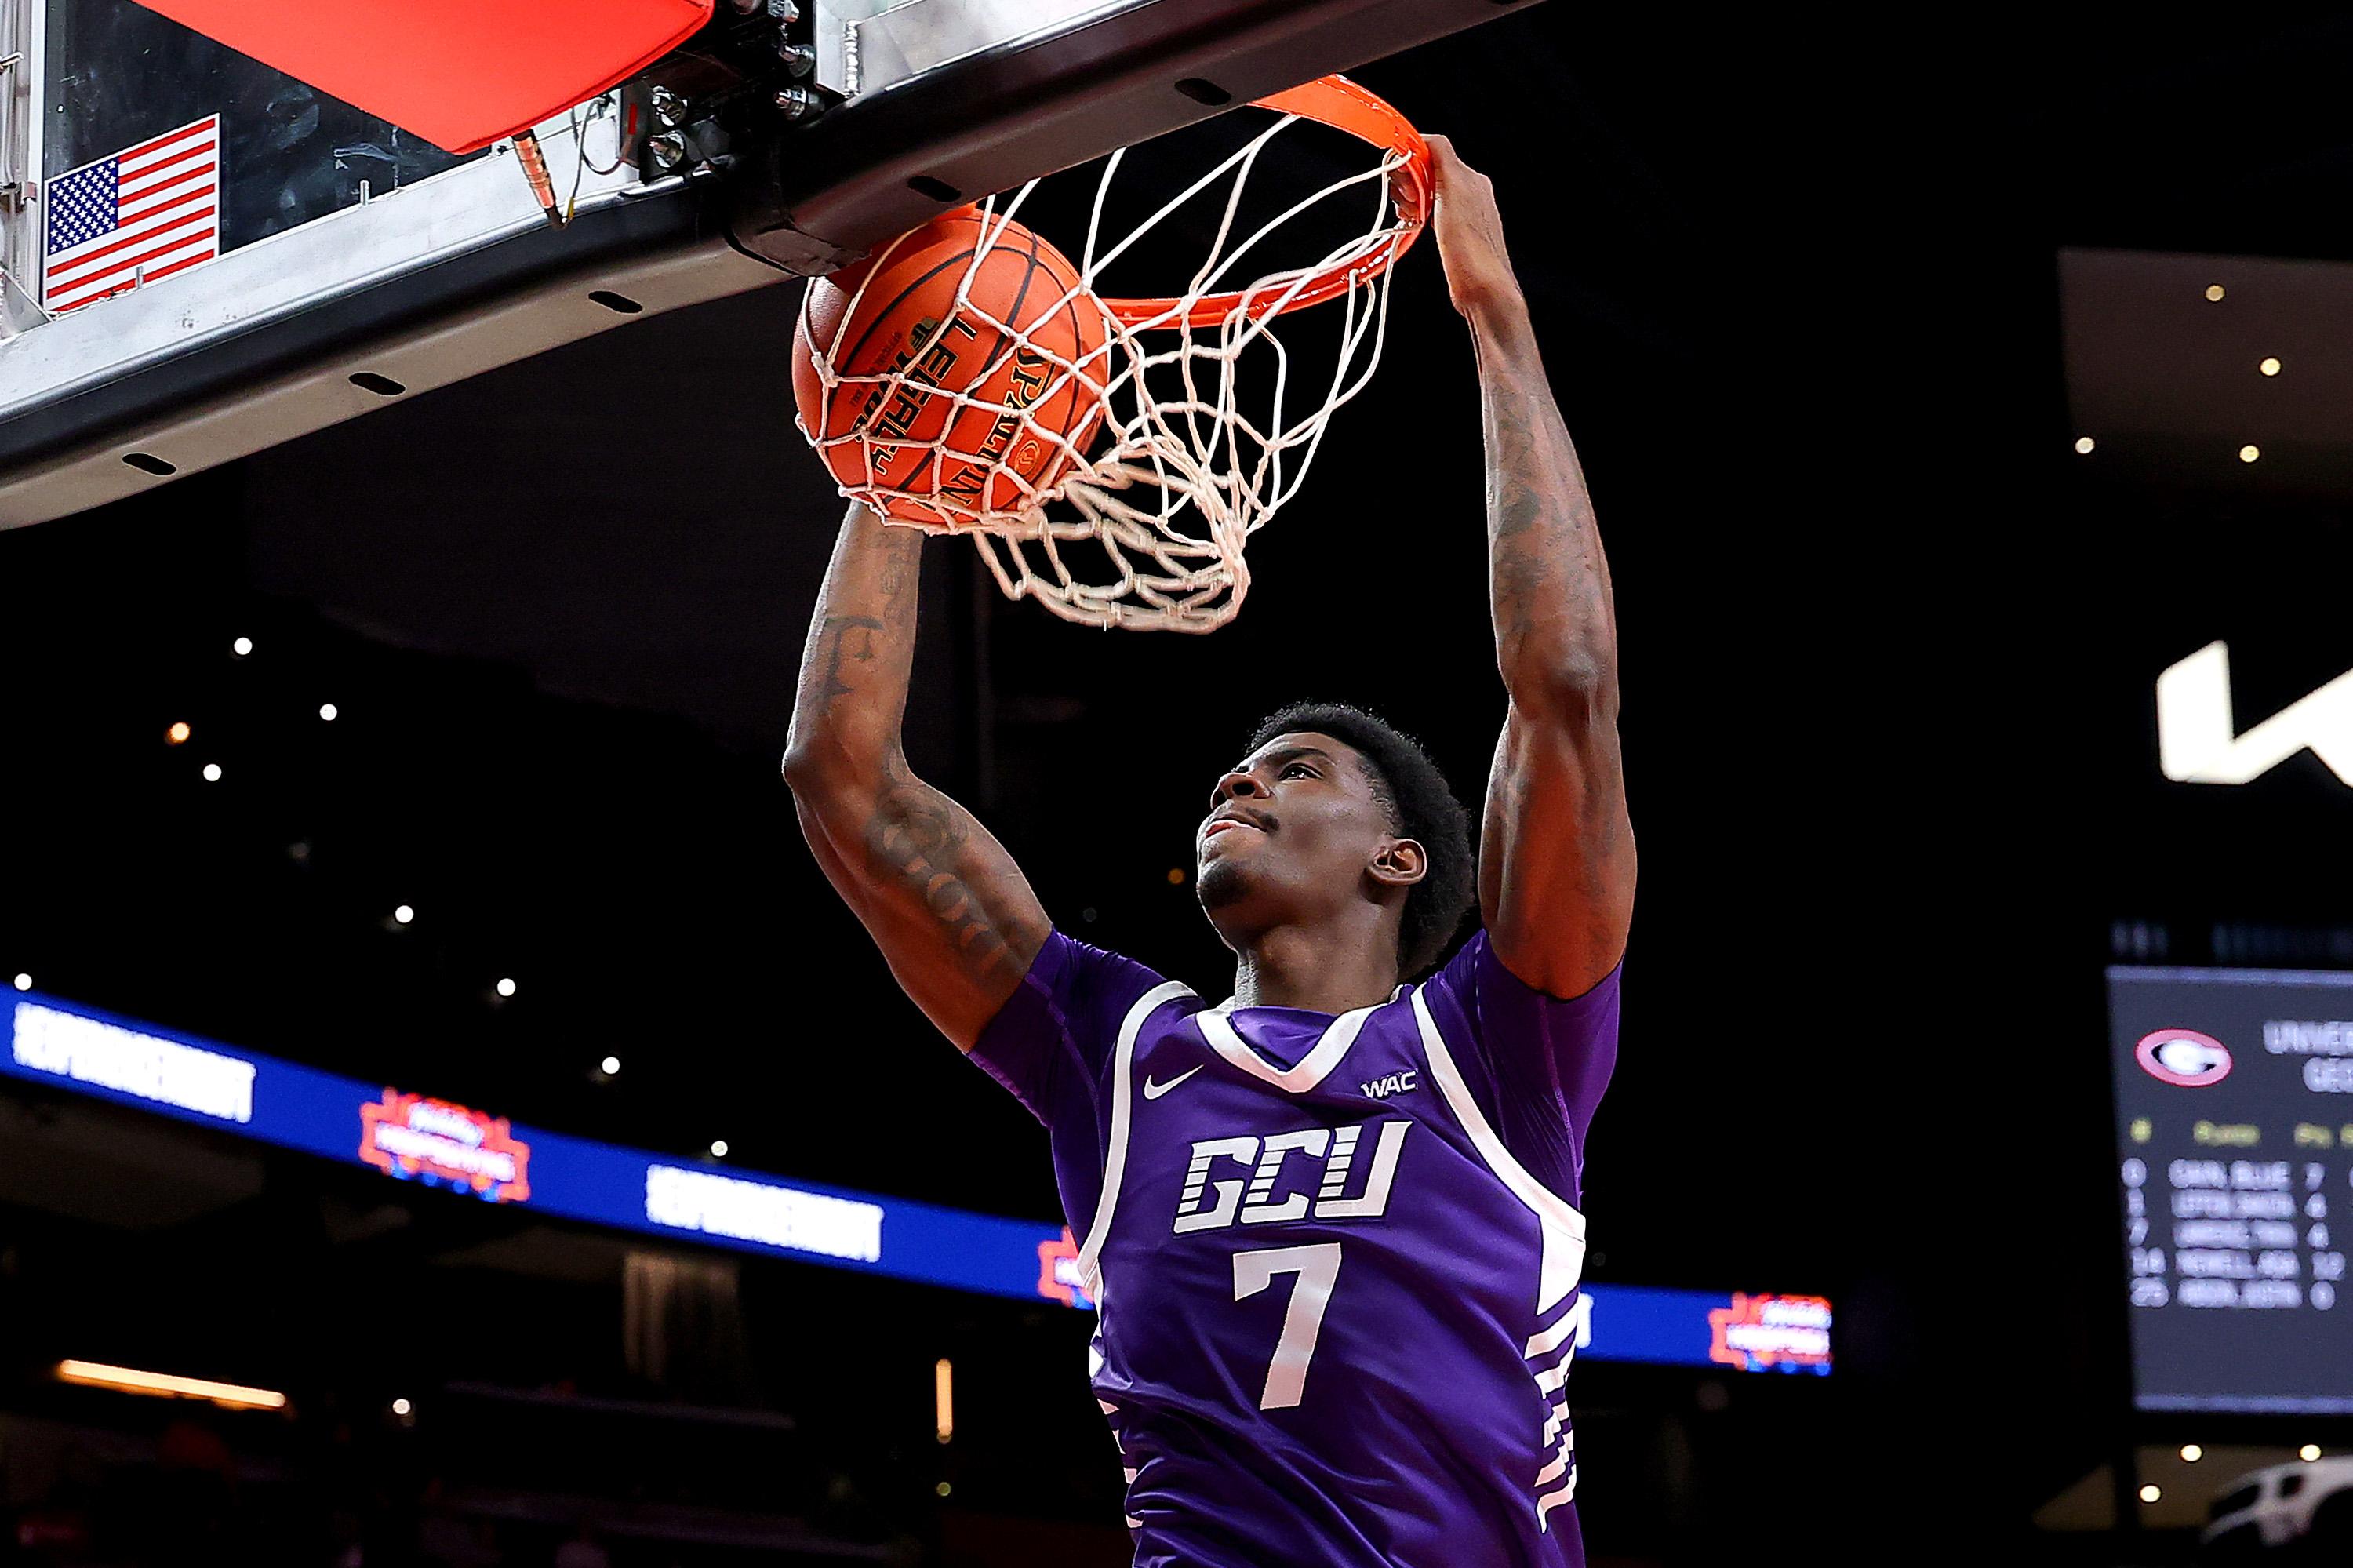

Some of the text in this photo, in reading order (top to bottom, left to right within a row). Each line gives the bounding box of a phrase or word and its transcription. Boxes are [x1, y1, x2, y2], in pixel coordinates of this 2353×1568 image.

[870, 315, 979, 476] LEGACY
[1361, 1070, 1418, 1098] WAC
[1173, 1121, 1413, 1234] GCU
[1233, 1242, 1342, 1410] 7
